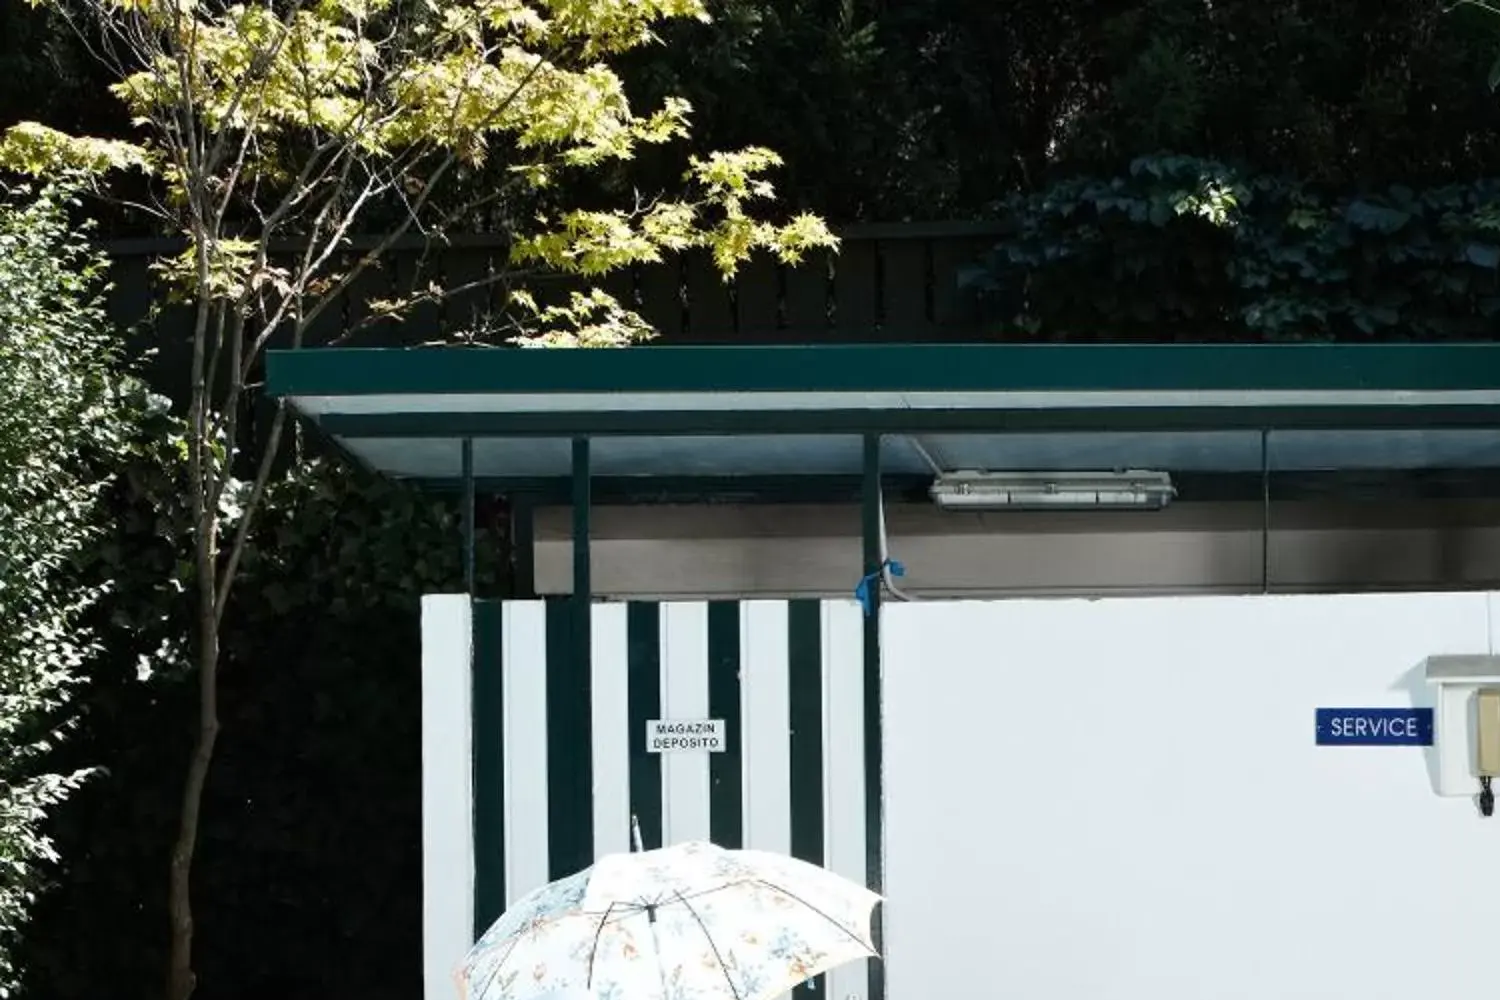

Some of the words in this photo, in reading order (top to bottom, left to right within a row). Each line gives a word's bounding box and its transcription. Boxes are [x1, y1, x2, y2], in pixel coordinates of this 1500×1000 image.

[656, 723, 715, 734] MAGAZIN
[1331, 717, 1418, 737] SERVICE
[653, 737, 719, 749] DEPOSITO
